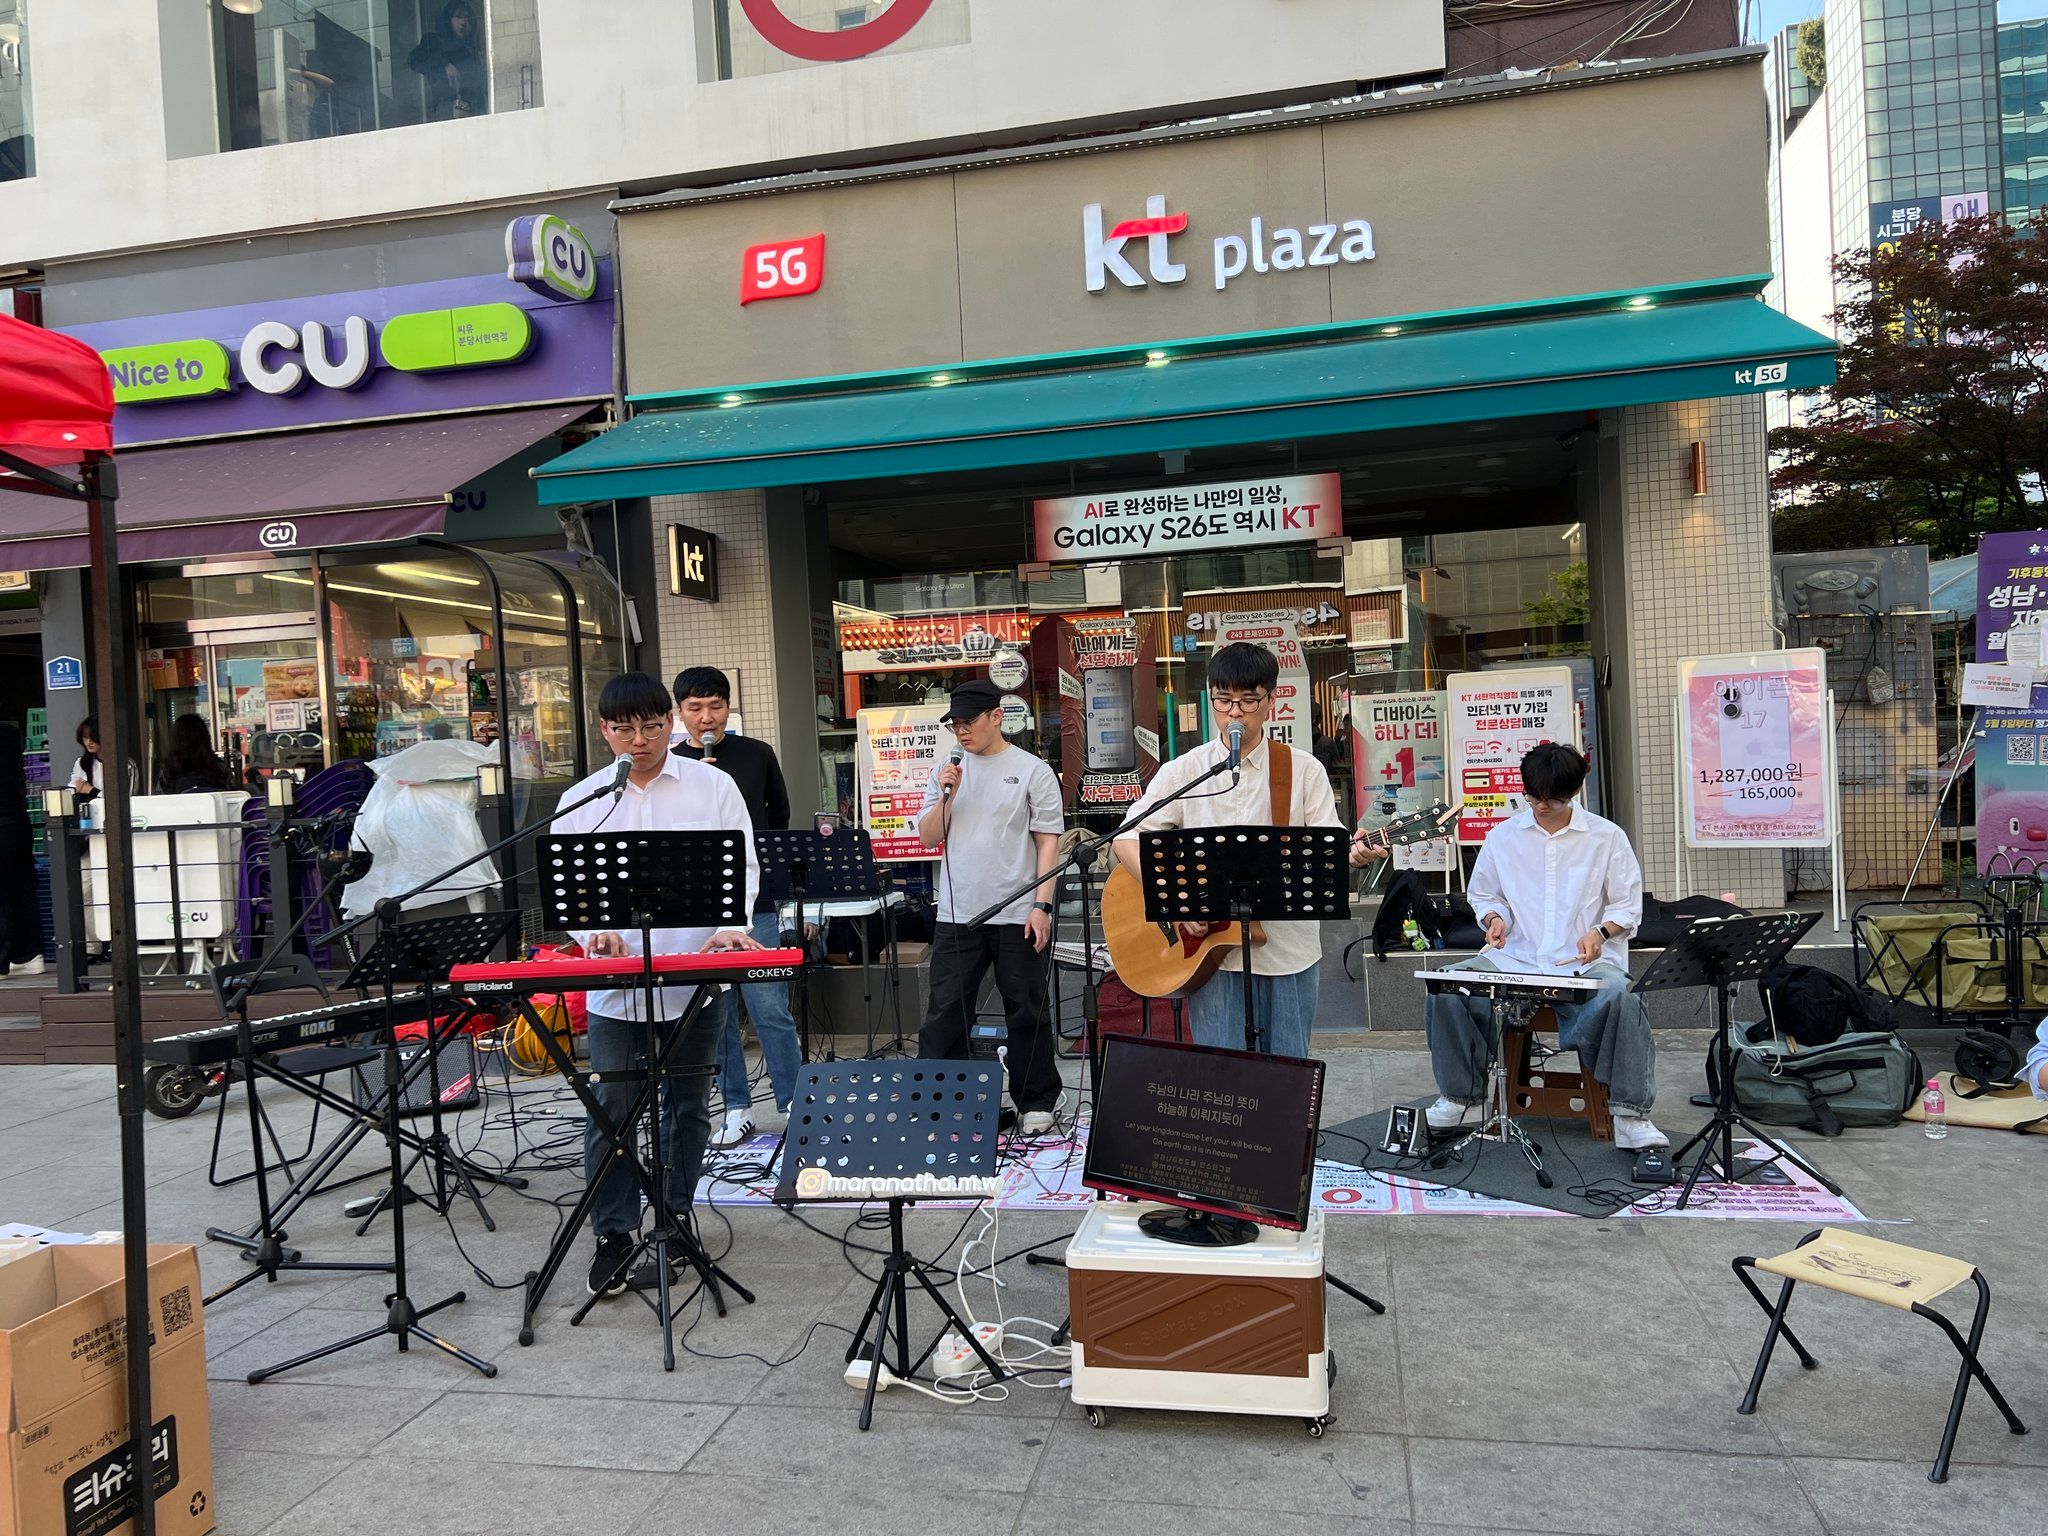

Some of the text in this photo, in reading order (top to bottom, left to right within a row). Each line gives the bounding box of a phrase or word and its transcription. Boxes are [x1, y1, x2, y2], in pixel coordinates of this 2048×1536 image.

[1084, 195, 1375, 294] kt plaza
[553, 235, 586, 279] CU
[756, 247, 807, 290] 5G
[457, 324, 474, 335] 씨유
[240, 315, 369, 395] CU
[108, 358, 203, 388] Nice to
[1735, 367, 1782, 385] kt 5G
[450, 490, 487, 513] CU
[1084, 485, 1287, 519] AI로 완성하는 나만의 일상,
[266, 528, 290, 541] CU
[1054, 504, 1320, 548] Galaxy S26도 역시 KT
[683, 535, 705, 583] kt
[1079, 621, 1102, 629] Galaxy
[1225, 613, 1250, 622] Galaxy
[1075, 635, 1138, 652] 나에게는
[56, 662, 70, 674] 21
[1079, 652, 1138, 668] 선명하게
[1461, 694, 1472, 702] KT
[1373, 705, 1437, 722] 디바이스
[1466, 702, 1549, 717] 인터넷 TV 가입
[1475, 716, 1546, 730] 전문상담매장
[1741, 711, 1767, 729] 17
[1374, 721, 1438, 741] 하나 더!
[902, 736, 915, 747] TV
[918, 735, 937, 746] 가입
[879, 748, 935, 761] 전문상담매장
[1084, 773, 1139, 784] 타인으로부터
[1507, 774, 1524, 784] 2만
[1700, 763, 1803, 785] 1,287,000원
[1081, 785, 1143, 802] 자유롭게
[191, 912, 209, 922] CU
[478, 981, 513, 993] Roland
[1478, 974, 1524, 983] OCTAPAD
[300, 1018, 336, 1038] KORG
[1147, 1082, 1259, 1111] 주님의 나라 주님의 뜻이
[1157, 1101, 1243, 1127] 하늘에 이뤄지듯이
[1125, 1121, 1272, 1154] Let your kingdom come Let your will be done
[1152, 1138, 1163, 1146] On
[1163, 1140, 1181, 1149] earth
[1213, 1148, 1238, 1159] heaven
[828, 1172, 998, 1195] maranatha.m.w
